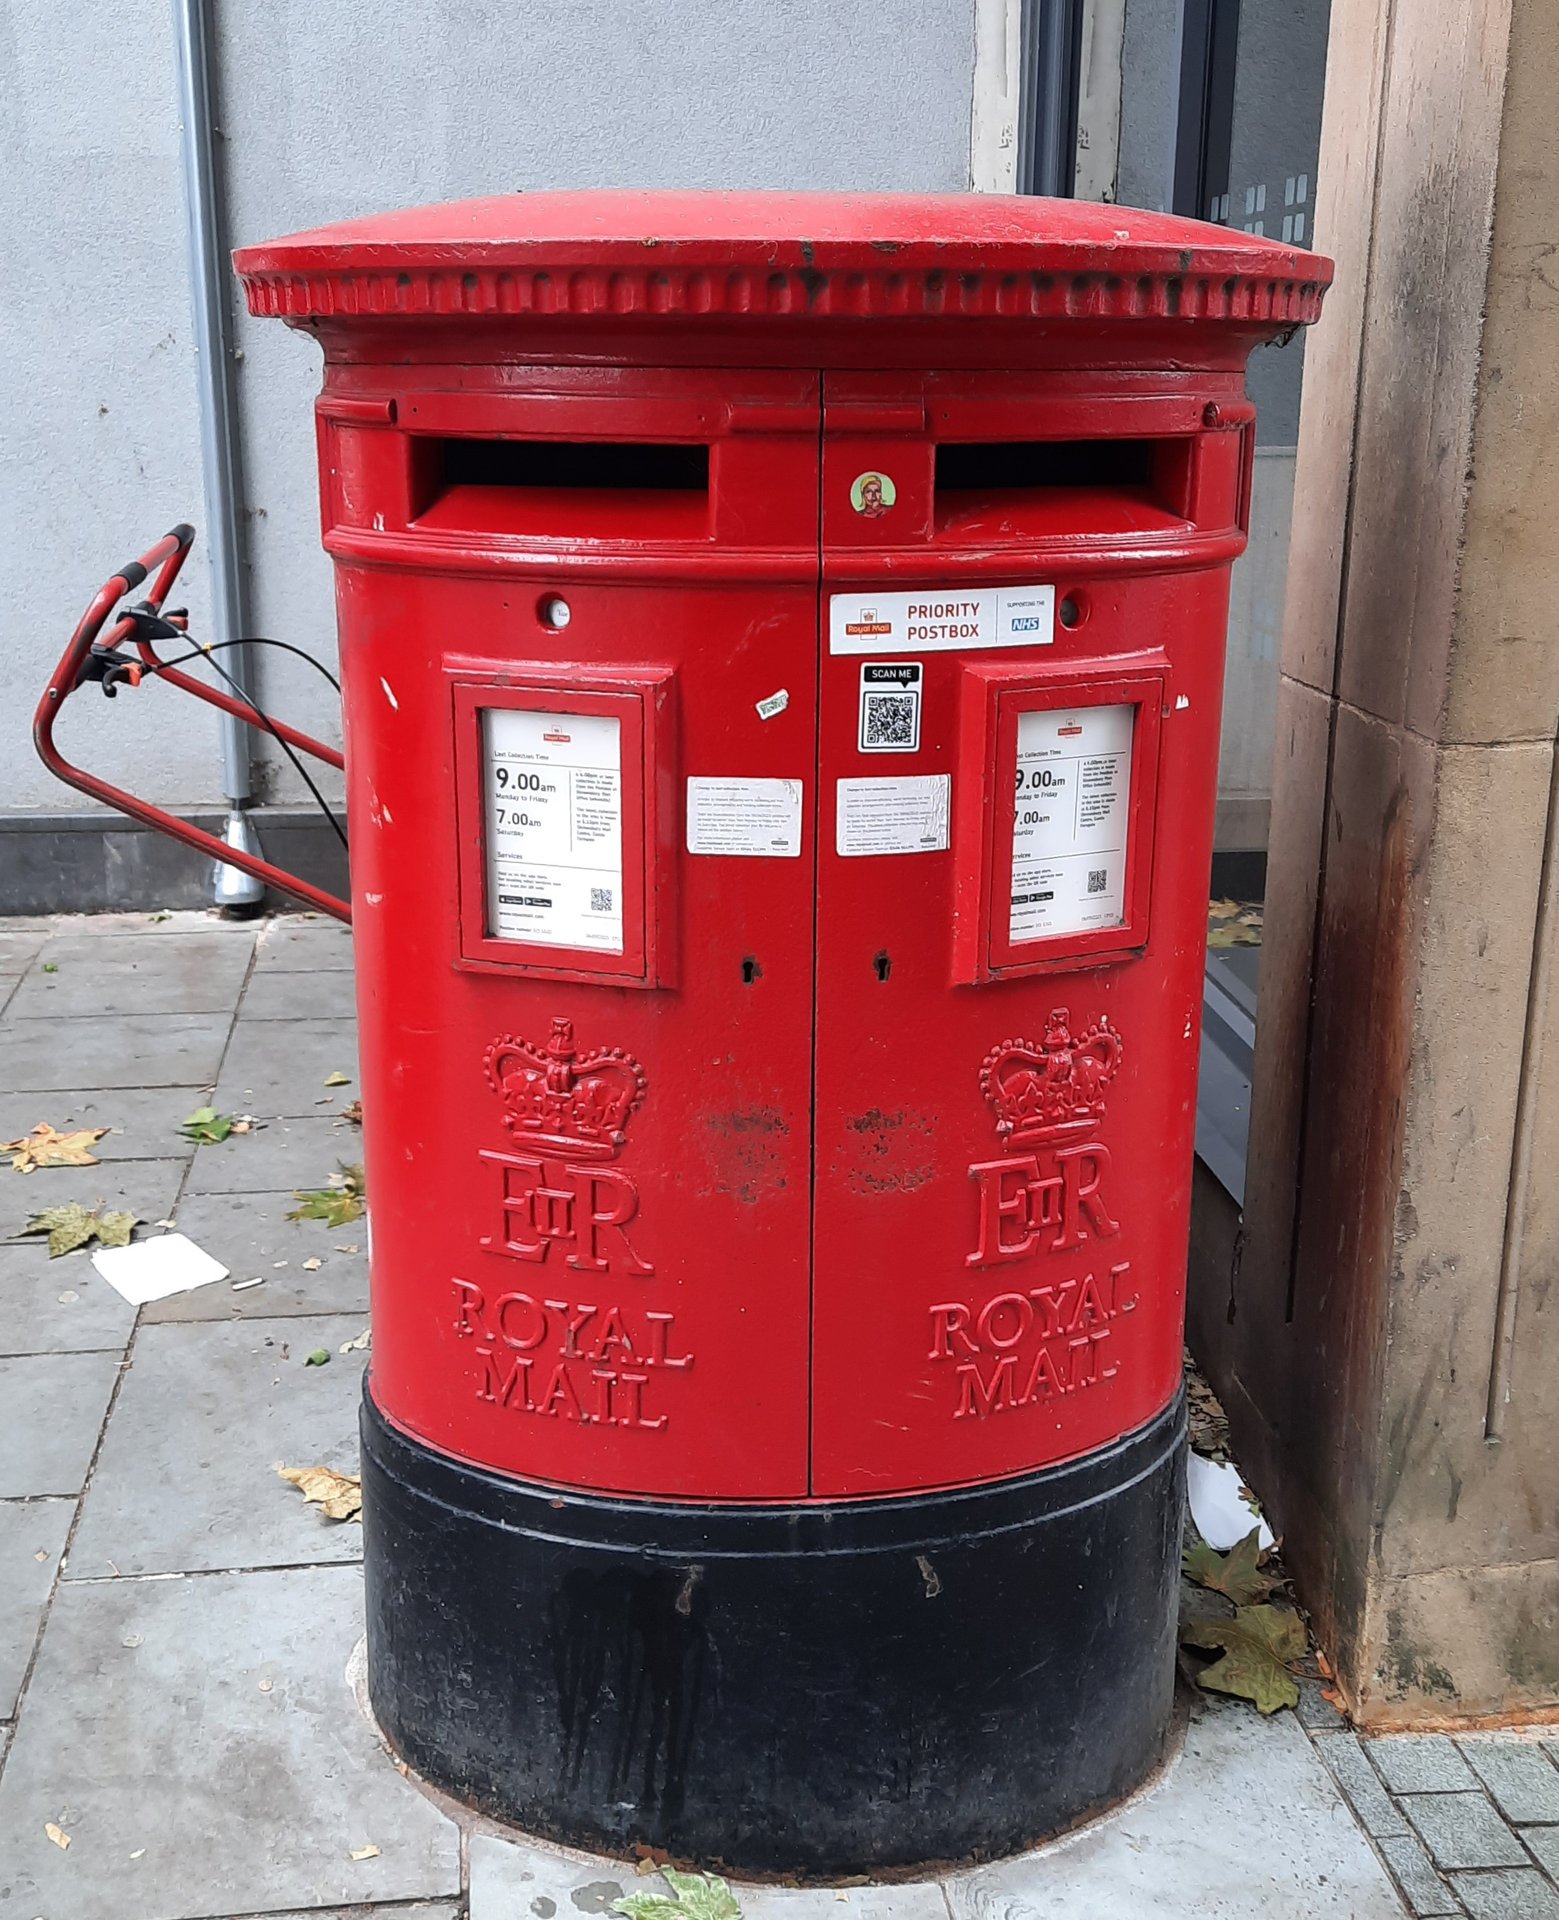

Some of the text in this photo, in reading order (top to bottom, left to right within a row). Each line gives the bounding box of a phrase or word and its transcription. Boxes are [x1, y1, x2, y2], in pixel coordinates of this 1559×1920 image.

[908, 602, 980, 619] PRIORITY
[848, 624, 890, 635] Royal Mail
[908, 624, 979, 640] POSTBOX
[1012, 618, 1038, 630] NHS
[872, 669, 912, 679] SCAN ME
[496, 767, 556, 792] 9.00am
[1015, 769, 1065, 791] 9.00am
[496, 793, 519, 801] Monday
[529, 795, 548, 803] Friday
[1016, 793, 1032, 801] onday
[1041, 790, 1058, 798] Friday
[496, 808, 542, 827] 7.00am
[496, 828, 524, 837] Saturday
[497, 851, 523, 860] Services
[928, 1261, 1140, 1360] ROYAL
[451, 1277, 696, 1368] ROYAL
[953, 1329, 1121, 1420] MAIL
[475, 1345, 669, 1430] MAIL
